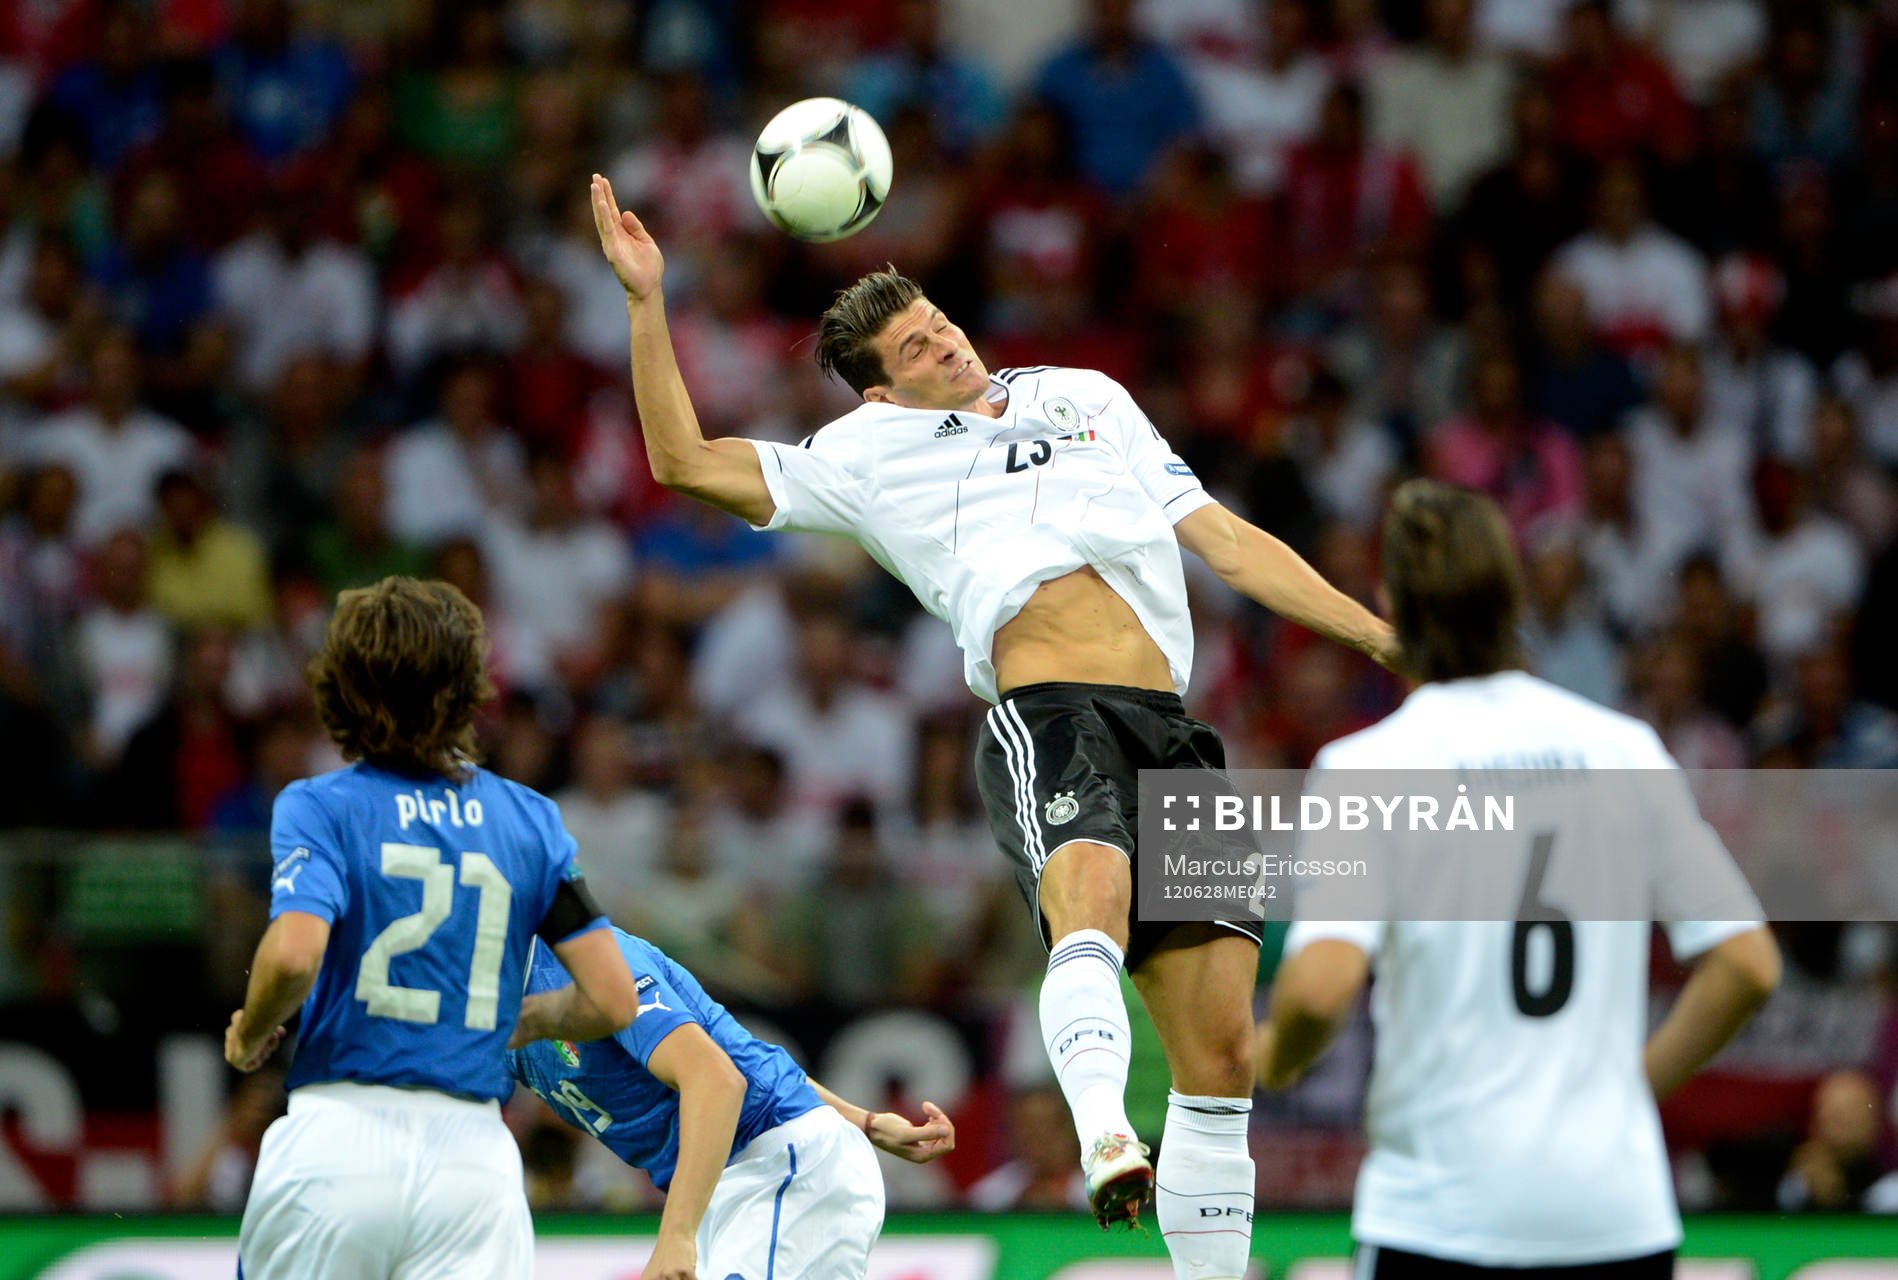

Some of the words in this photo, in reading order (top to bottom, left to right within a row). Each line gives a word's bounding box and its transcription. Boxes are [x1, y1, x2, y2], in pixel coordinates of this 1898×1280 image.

[934, 426, 968, 438] adidas
[395, 789, 484, 831] pirlo
[354, 842, 513, 1031] 21
[1513, 834, 1574, 1017] 6
